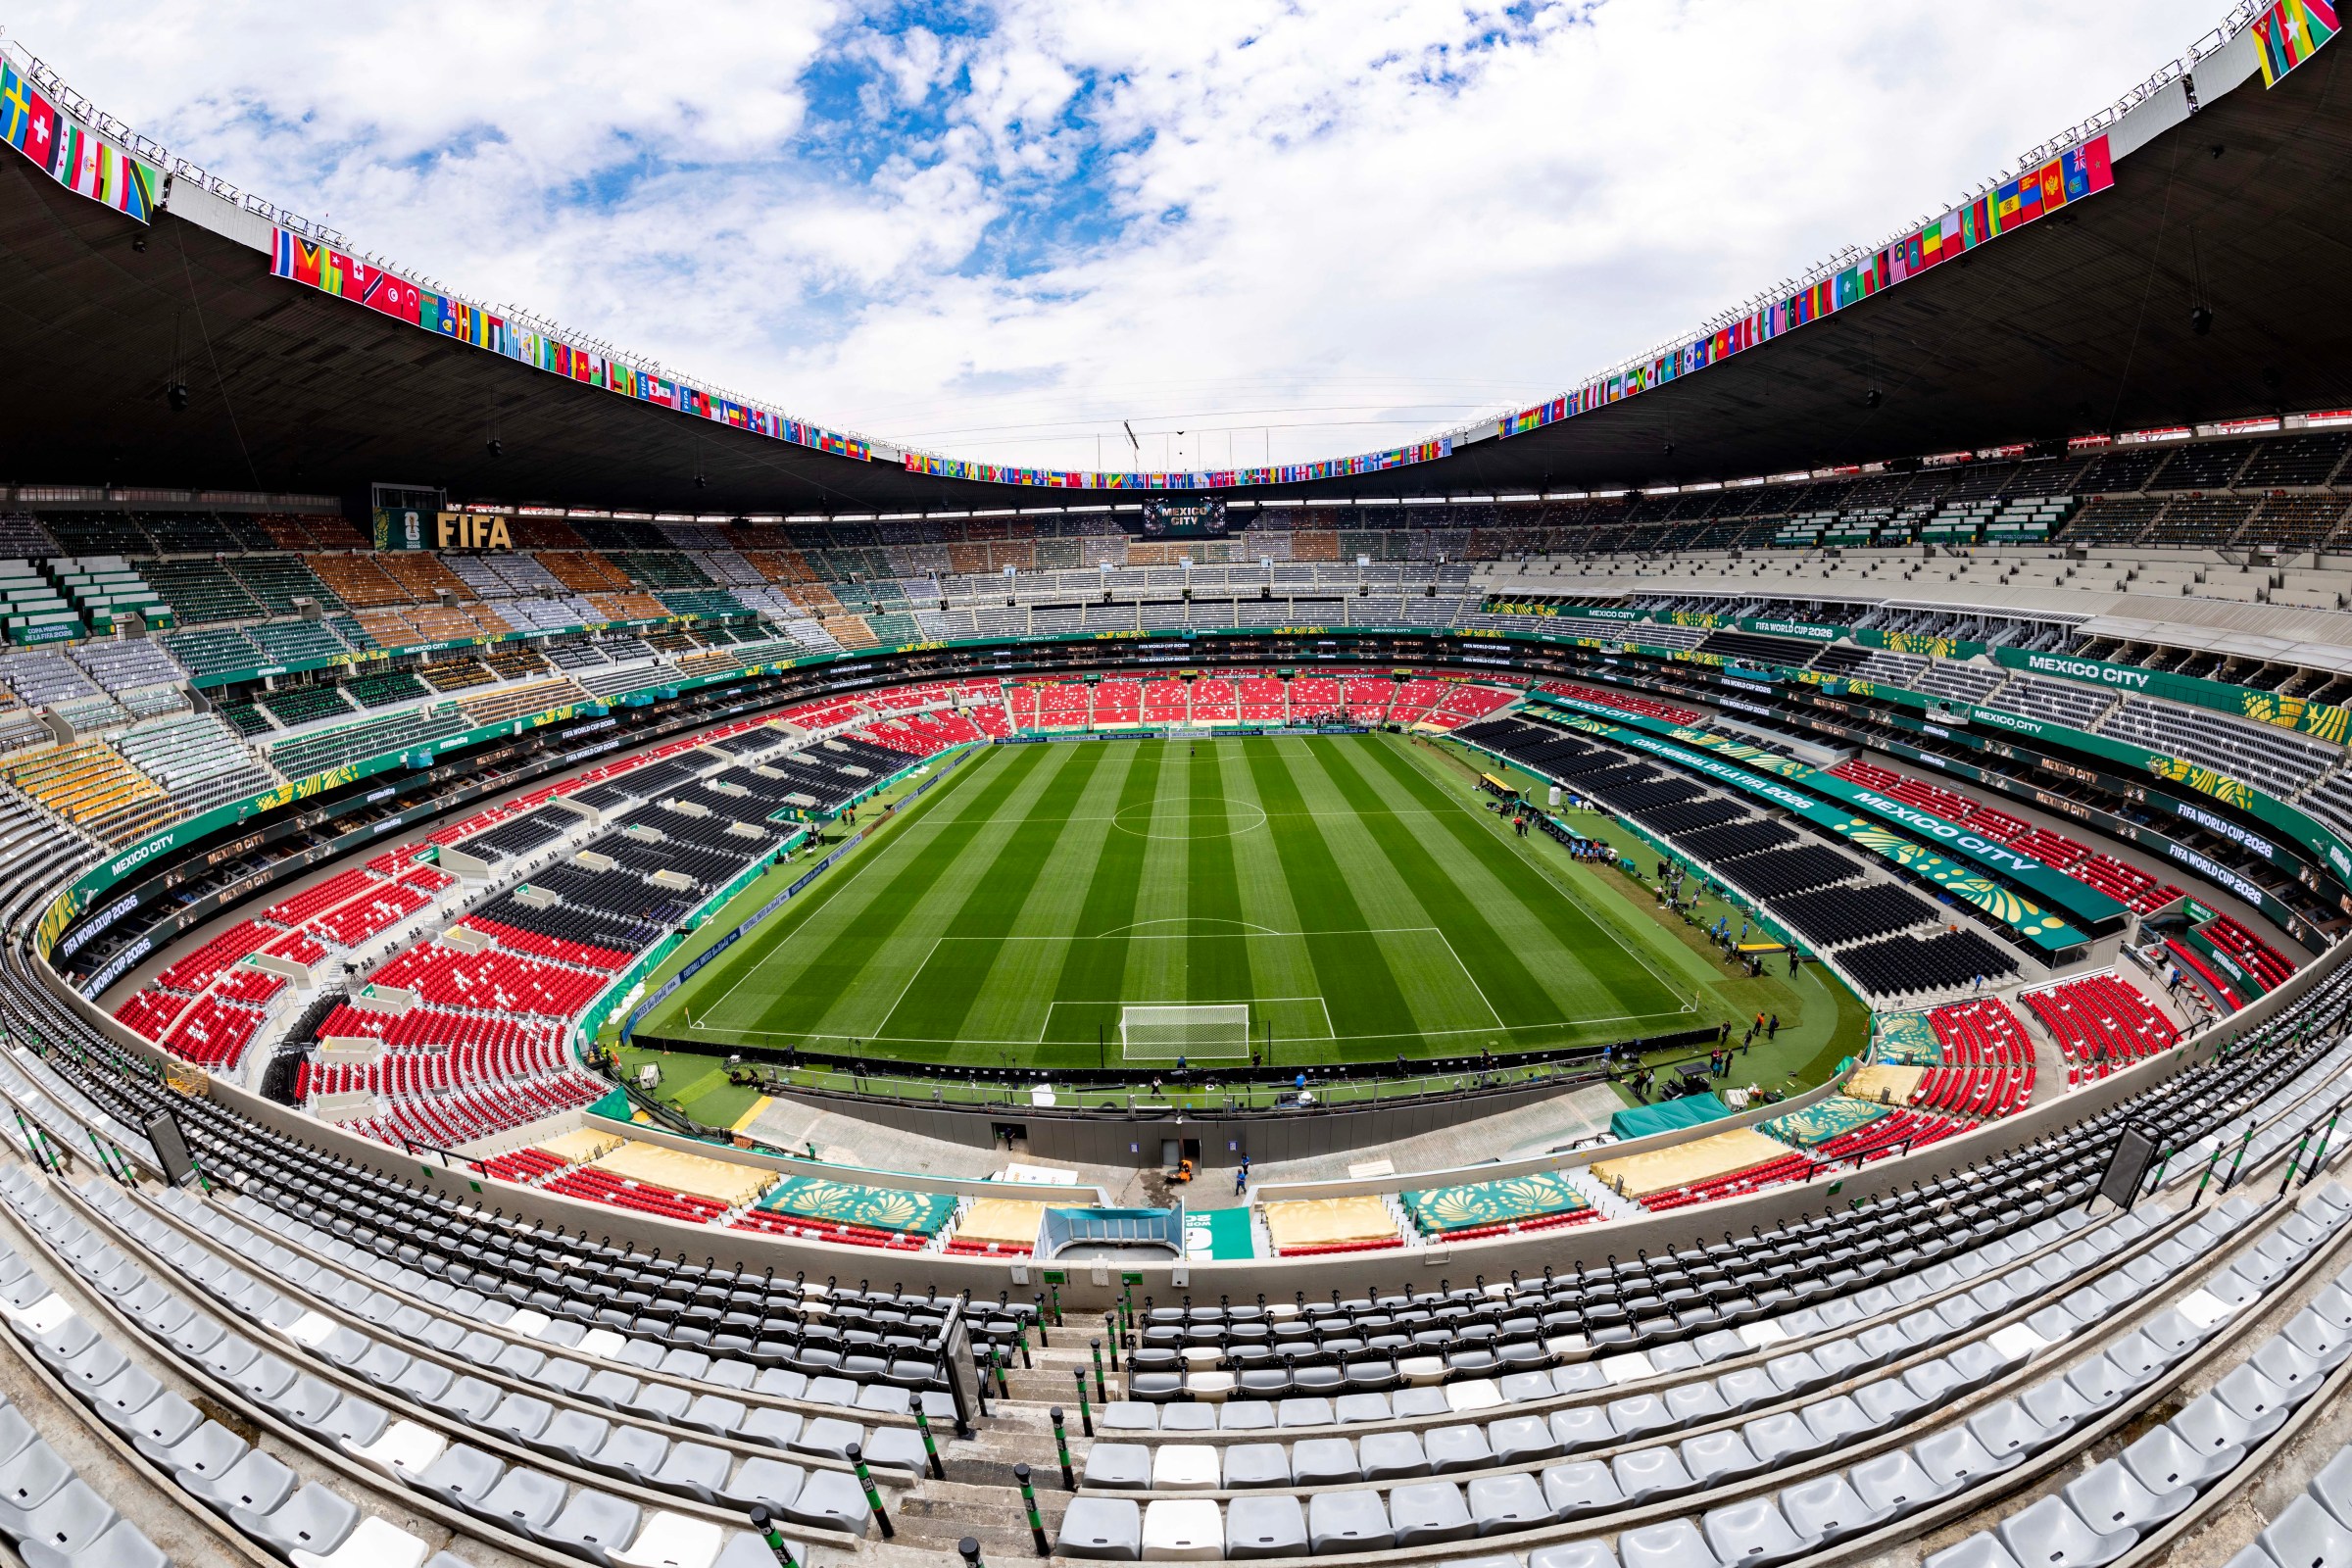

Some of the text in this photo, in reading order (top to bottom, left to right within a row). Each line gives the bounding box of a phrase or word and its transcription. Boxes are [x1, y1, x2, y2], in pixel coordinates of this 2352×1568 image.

[1162, 507, 1207, 516] MEXICO
[1171, 516, 1198, 525] CITY
[437, 513, 512, 549] FIFA
[44, 624, 69, 633] MUNDIAL
[1756, 622, 1833, 637] FIFA WORLD CUP 2026
[404, 642, 449, 654] MEXICO CITY
[705, 674, 724, 683] MEXICO
[2029, 656, 2149, 687] MEXICO CITY
[1731, 680, 1745, 689] WORLD
[1754, 684, 1771, 694] 2026
[1555, 698, 1643, 721] MEXICO CITY
[1720, 698, 1730, 707] FIFA
[1730, 701, 1744, 710] WORLD
[1752, 706, 1769, 715] 2026
[573, 726, 590, 736] WORLD
[591, 723, 600, 732] CUP
[600, 718, 615, 729] 2026
[1975, 710, 2042, 734] MEXICO CITY
[566, 741, 619, 762] FIFA WORLD CUP 2026
[1633, 739, 1814, 809] COPA MUNDIAL DE LA FIFA 2026
[2041, 759, 2098, 784] MEXICO CITY
[2036, 792, 2092, 819] MEXICO CITY
[1852, 792, 2038, 870] MEXICO CITY
[2178, 804, 2273, 858] FIFA WORLD CUP 2026
[112, 834, 174, 876] MEXICO CITY
[208, 834, 265, 865] MEXICO CITY
[219, 871, 273, 904] MEXICO CITY
[2170, 845, 2262, 906] FIFA WORLD CUP 2026
[63, 941, 77, 956] FIFA
[111, 894, 138, 915] 2026
[112, 960, 125, 976] CUP
[125, 939, 151, 962] 2026
[683, 962, 701, 978] FOOTBALL
[700, 952, 712, 965] UNITES
[654, 987, 666, 1005] World
[667, 981, 676, 991] FIFA
